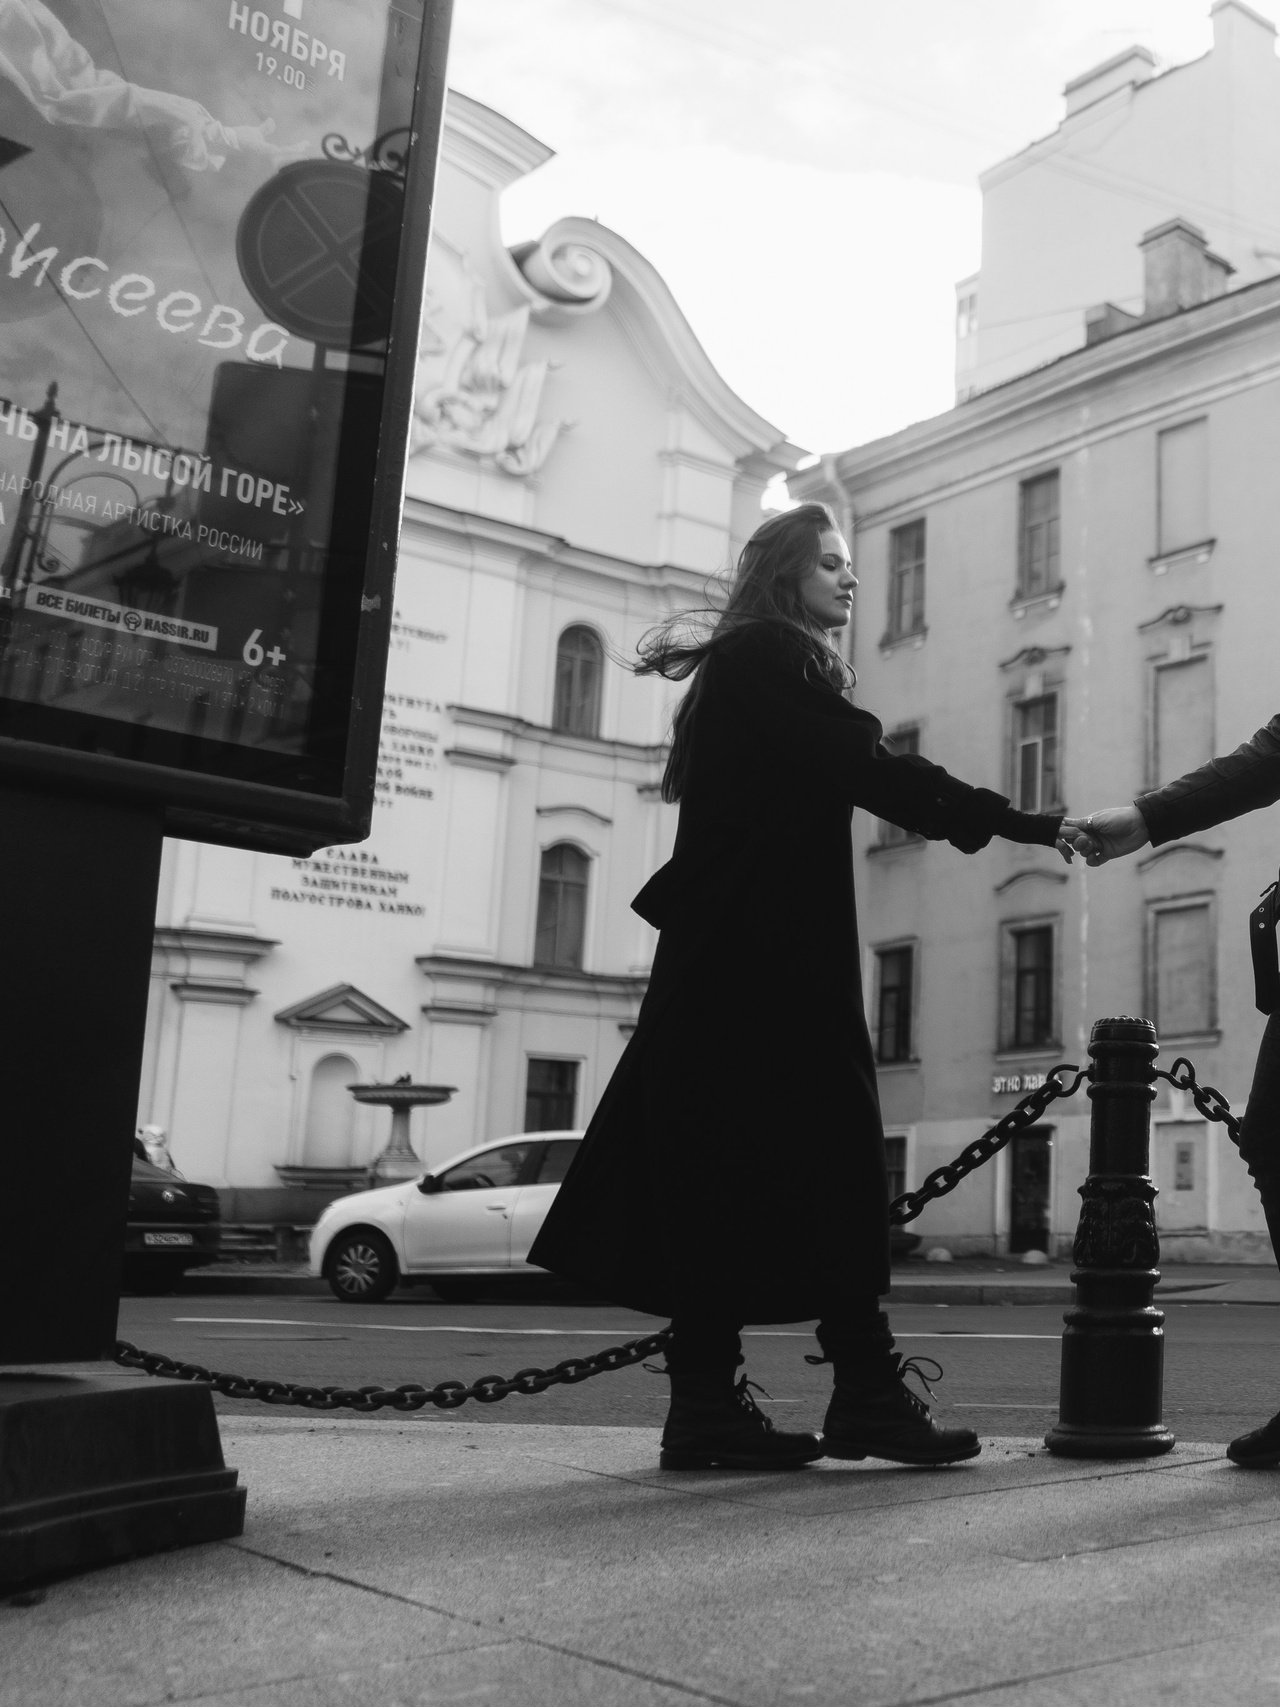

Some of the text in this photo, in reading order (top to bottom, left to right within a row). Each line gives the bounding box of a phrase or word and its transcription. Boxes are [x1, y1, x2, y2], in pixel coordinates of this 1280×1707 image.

[228, 0, 346, 82] НОЯБРЯ
[256, 52, 306, 91] 19.00
[0, 222, 290, 370] исеева
[47, 416, 90, 458] НА
[98, 432, 213, 493] ЛЫСОЙ
[220, 468, 304, 516] ГОРЕ»
[101, 497, 193, 541] АРТИСТКА
[198, 525, 264, 561] РОССИИ
[36, 592, 65, 611] ВСЕ
[66, 598, 122, 625] БИЛЕТЫ
[144, 616, 211, 644] KASSIR.RU
[242, 628, 287, 667] 6+
[270, 887, 373, 911] ПОЛУОСТРОВА
